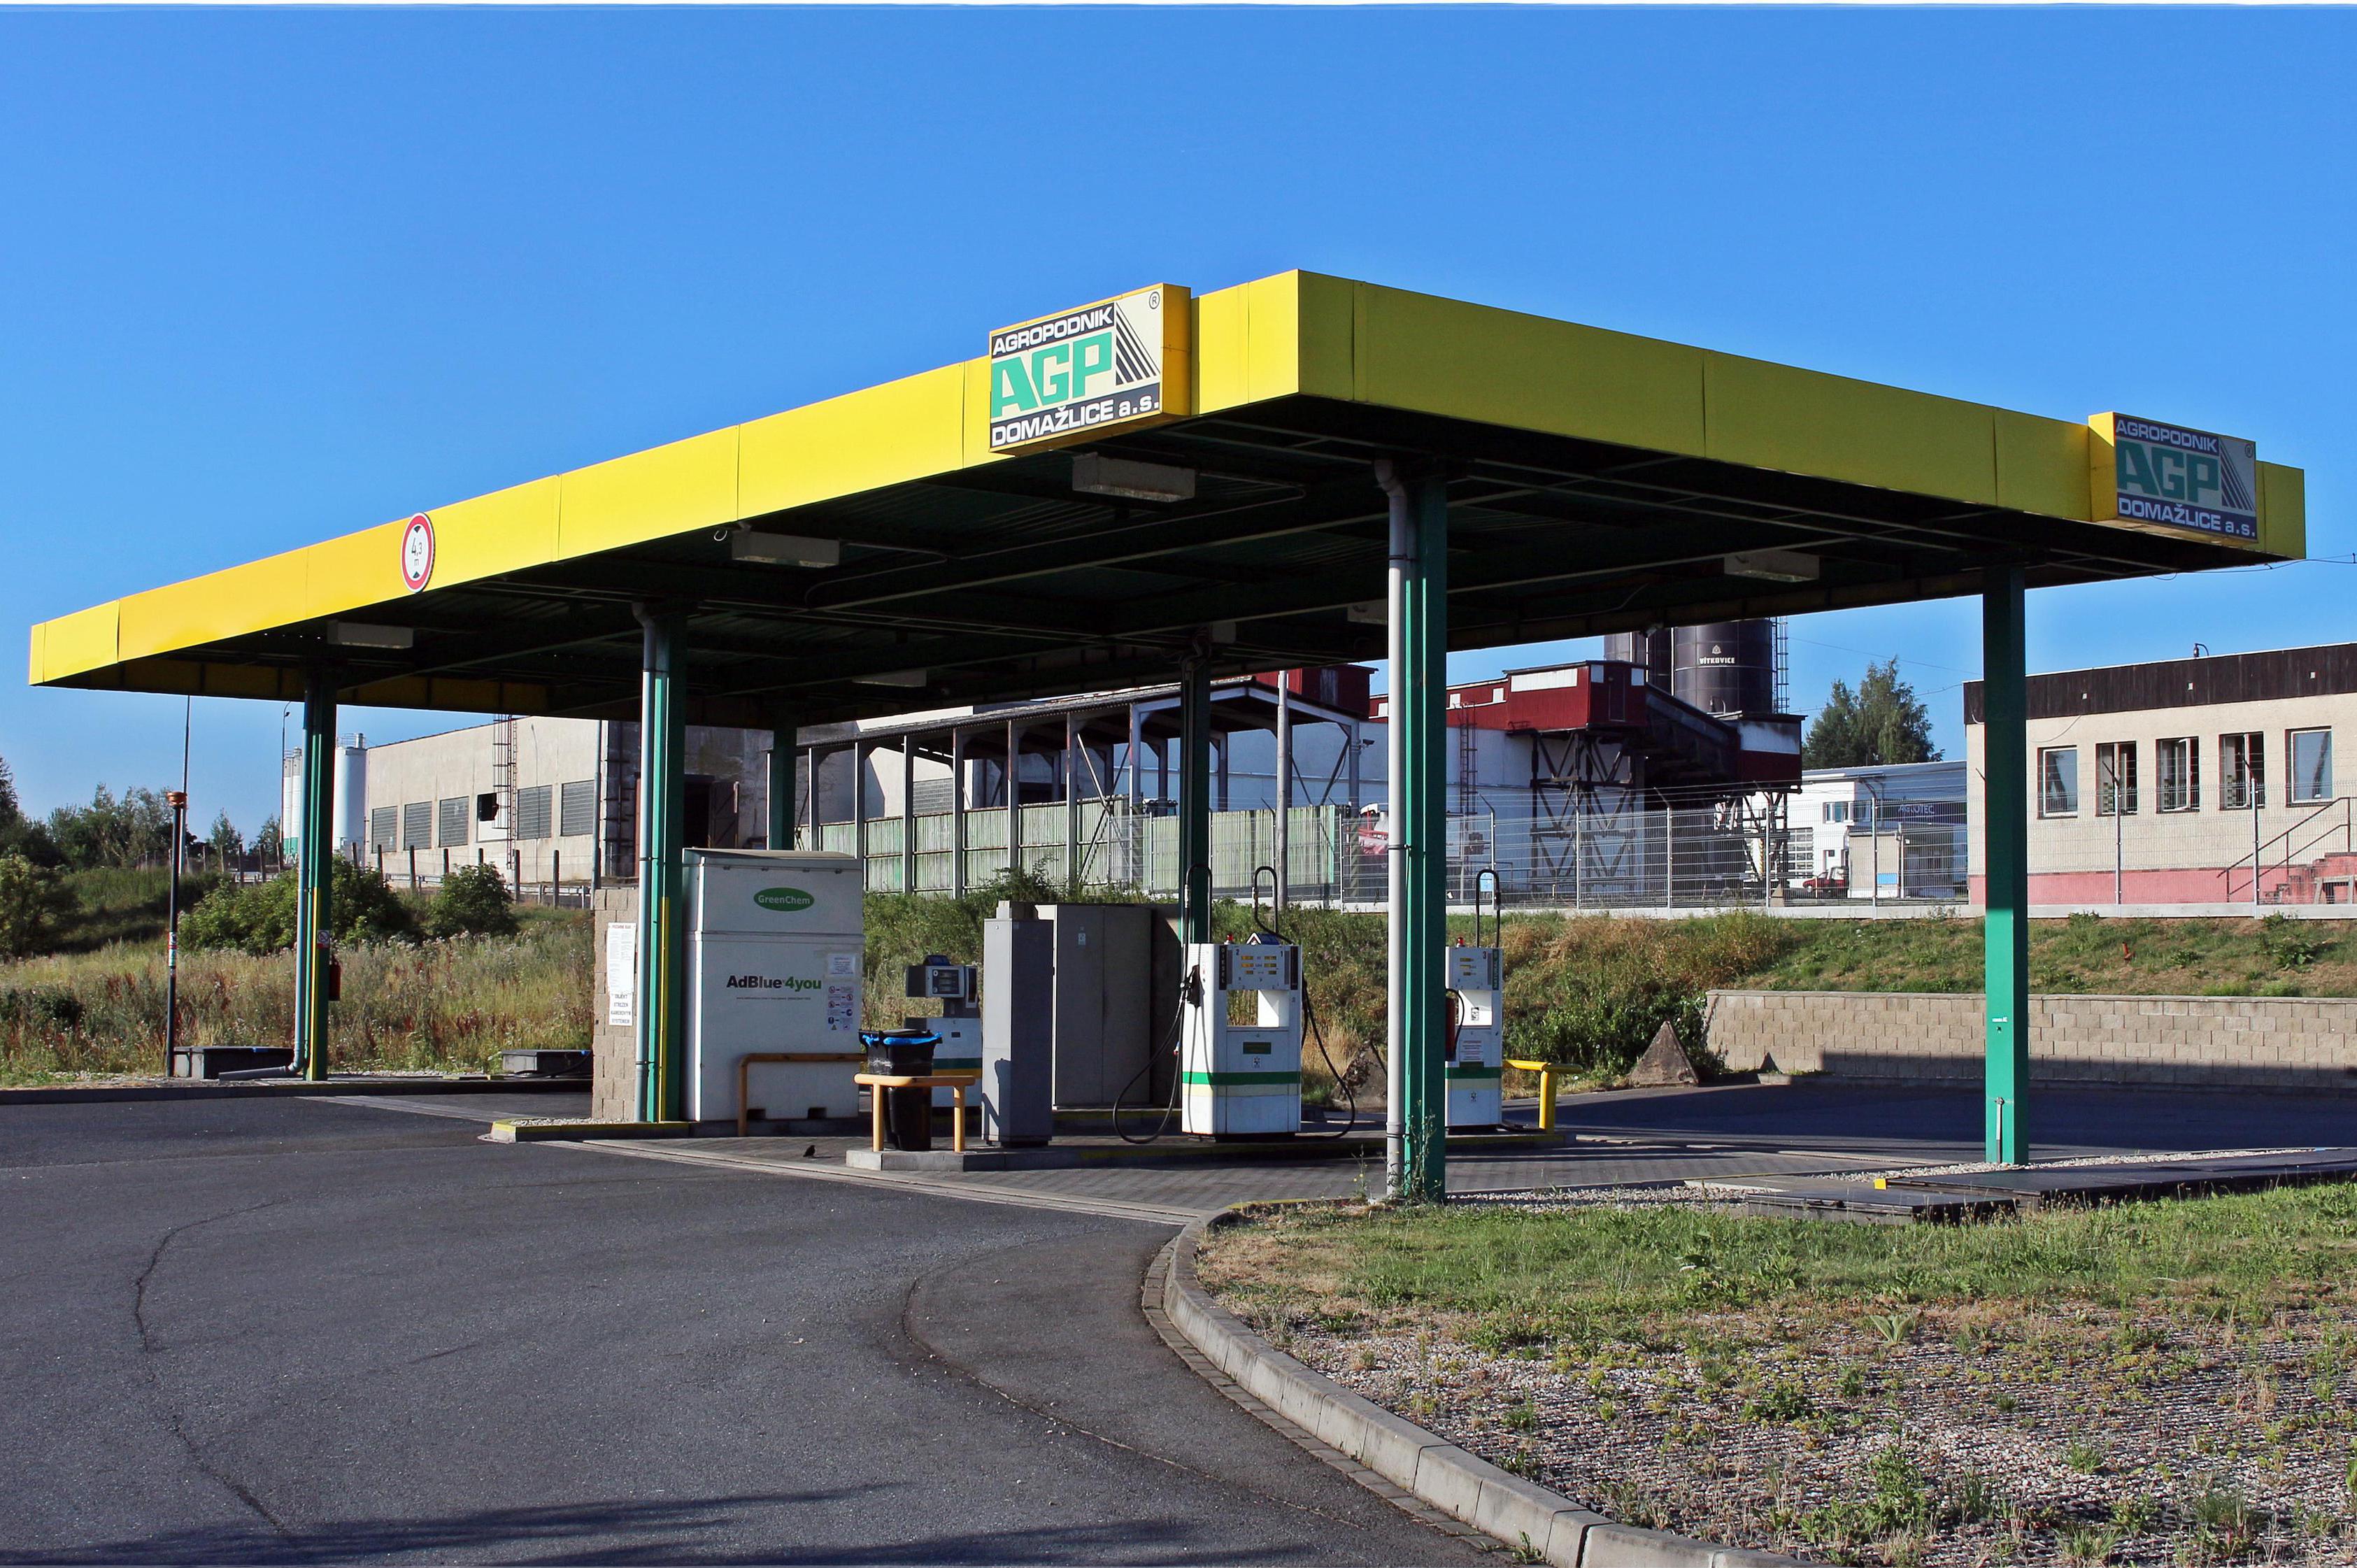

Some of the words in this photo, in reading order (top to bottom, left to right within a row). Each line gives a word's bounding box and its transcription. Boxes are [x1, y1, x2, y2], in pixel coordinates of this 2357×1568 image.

[992, 306, 1113, 356] AGROPODNIK
[991, 332, 1112, 418] AGP
[992, 399, 1113, 446] DOMAŽLICE
[1118, 394, 1160, 416] a.s.
[2116, 419, 2218, 452] AGROPODNIK
[2116, 439, 2219, 503] AGP
[2118, 497, 2221, 531] DOMAŽLICE
[2224, 520, 2256, 537] a.s.
[411, 537, 422, 557] 4,3
[1699, 656, 1735, 664] VÍTKOVICE
[757, 895, 811, 904] GreenChem
[1483, 950, 1487, 959] 3
[727, 975, 783, 988] AdBlue
[785, 976, 822, 992] 4you
